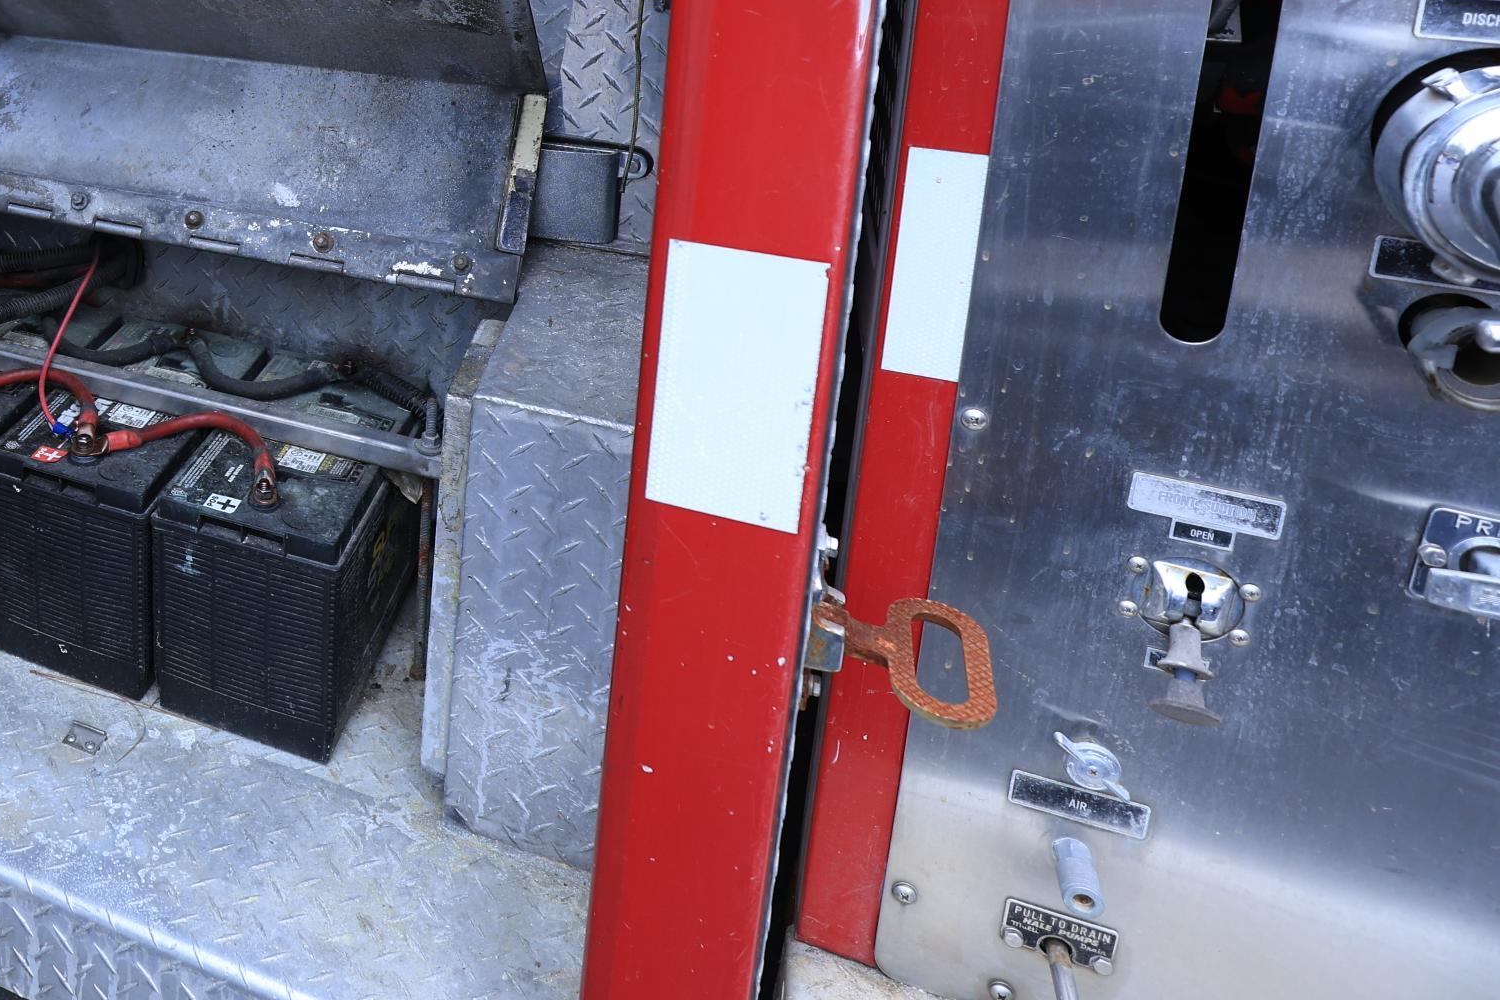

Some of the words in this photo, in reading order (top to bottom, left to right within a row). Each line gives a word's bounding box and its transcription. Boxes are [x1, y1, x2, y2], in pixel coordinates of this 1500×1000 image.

[1455, 513, 1500, 537] PR
[1190, 528, 1214, 541] OPEN
[1068, 799, 1088, 811] AIR
[1014, 905, 1044, 922] PULL
[1051, 917, 1066, 929] TO
[1071, 923, 1111, 943] DRAIN
[1058, 929, 1099, 947] PUMPS
